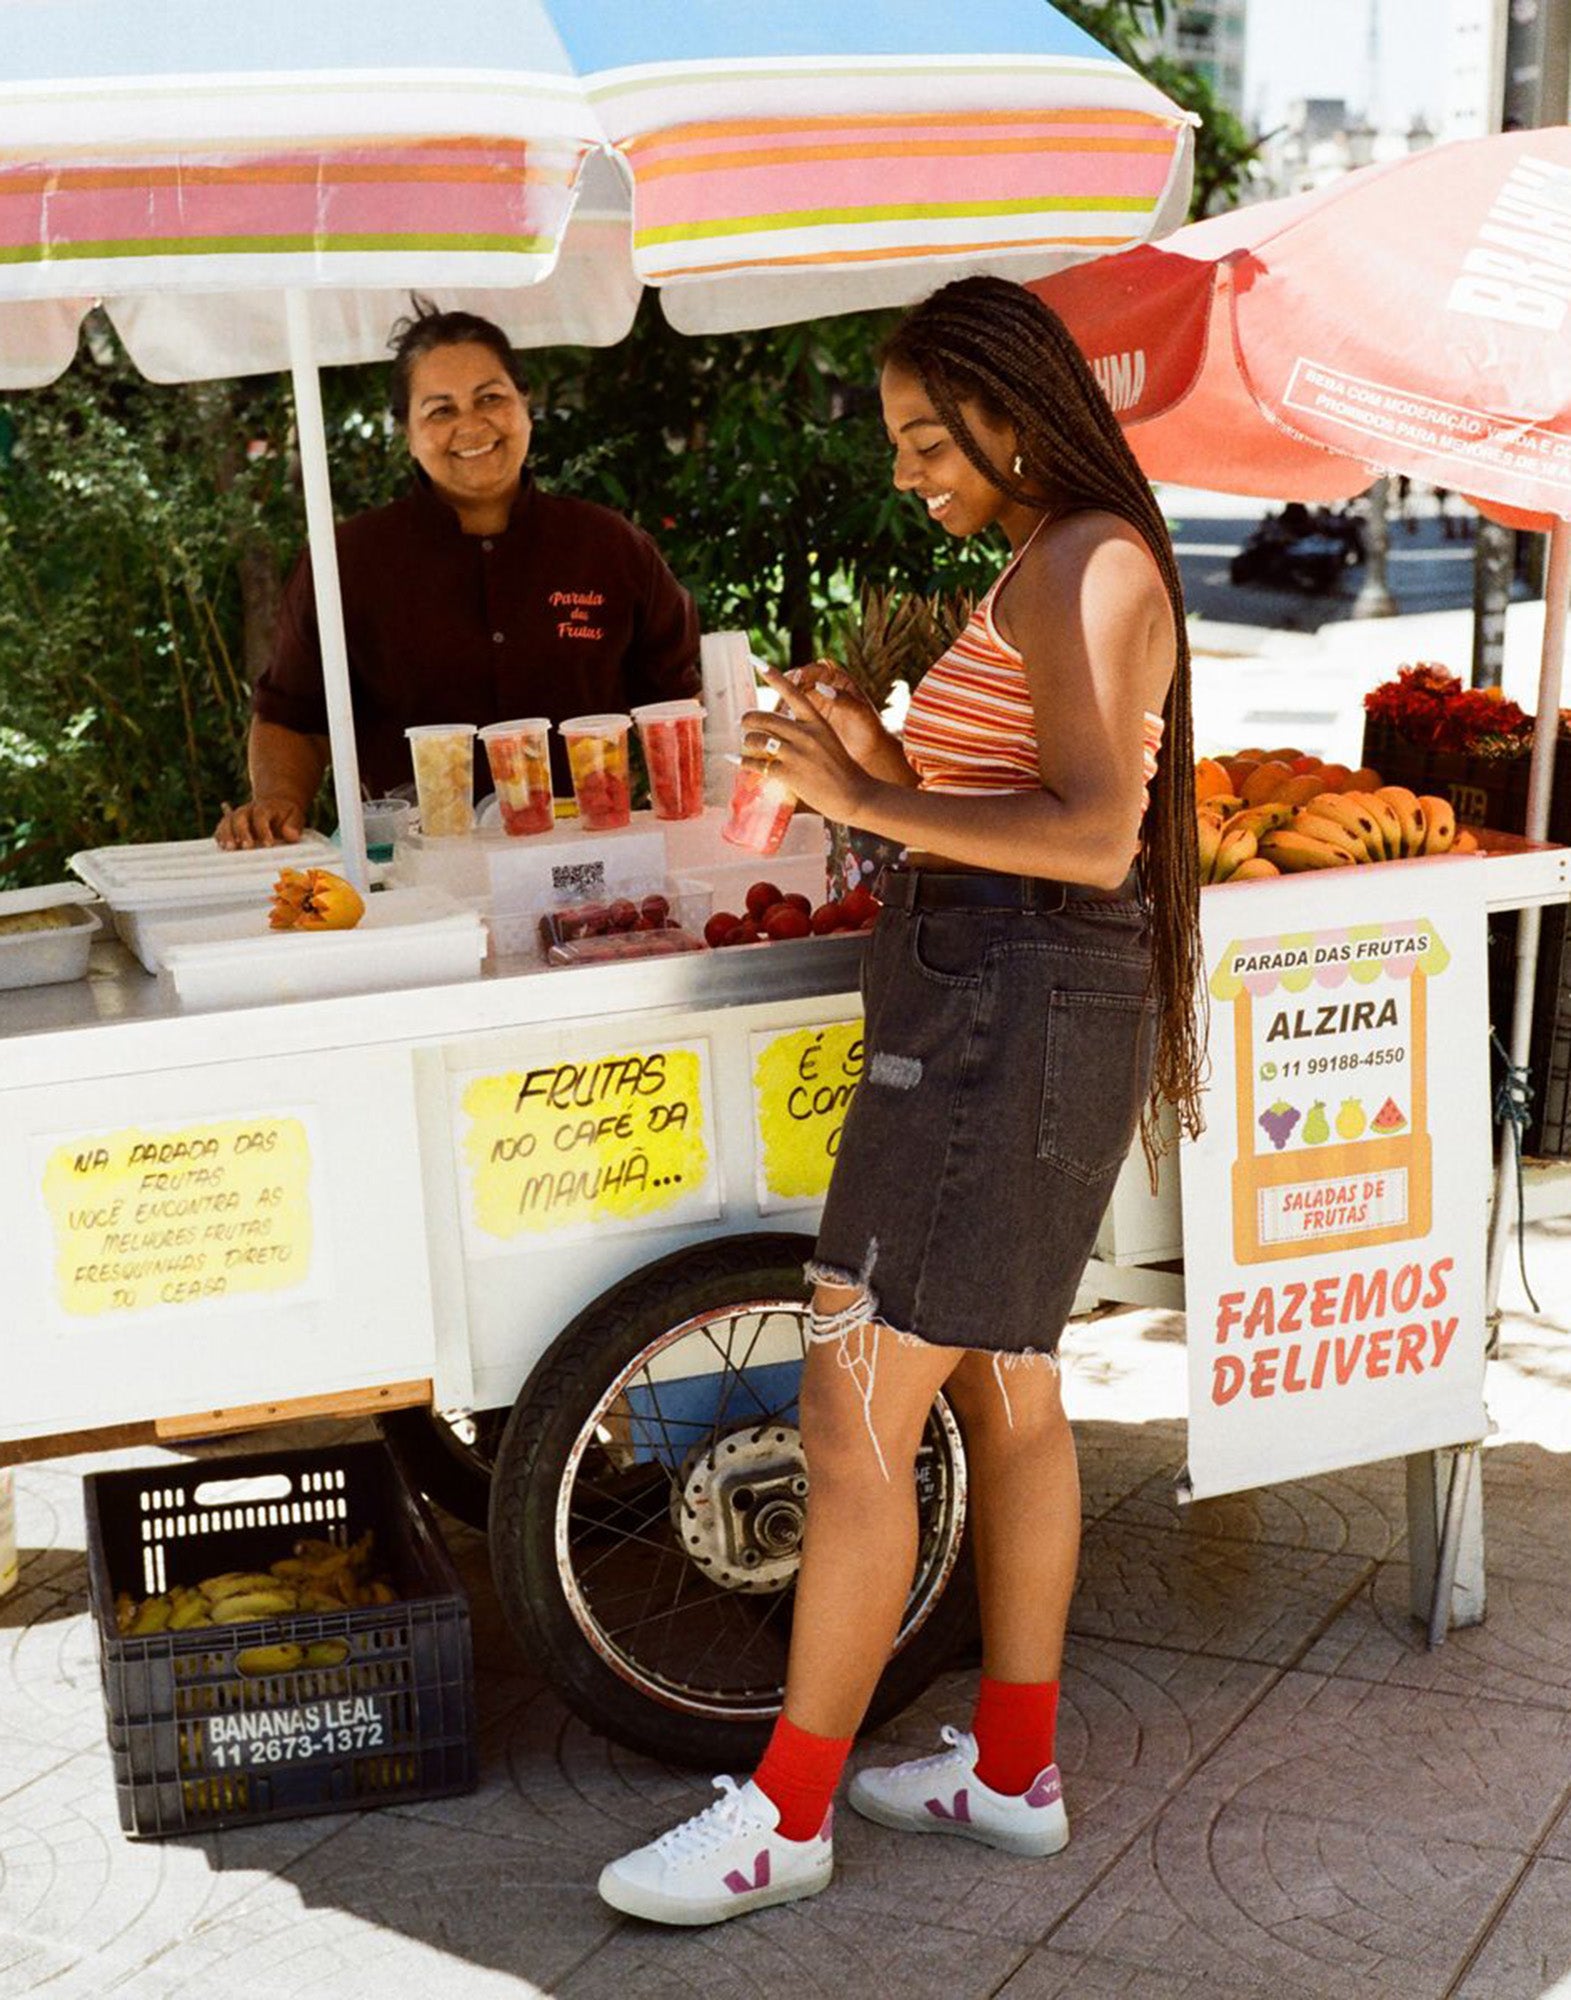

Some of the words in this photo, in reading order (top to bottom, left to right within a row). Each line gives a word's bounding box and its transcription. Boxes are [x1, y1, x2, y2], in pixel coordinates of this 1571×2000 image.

[1086, 349, 1146, 412] HMA
[1305, 369, 1346, 395] BEBA
[1346, 386, 1382, 406] COM
[1396, 421, 1438, 446] PARA
[1439, 434, 1514, 468] MENORES
[549, 590, 606, 606] Parada
[556, 622, 604, 640] Frutas
[1233, 950, 1308, 973] PARADA
[1314, 945, 1351, 964] DAS
[1356, 936, 1428, 959] FRUTAS
[1266, 998, 1398, 1042] ALZIRA
[799, 1032, 825, 1080] É
[1282, 1060, 1301, 1078] 11
[1307, 1047, 1405, 1074] 99188-4550
[515, 1053, 667, 1113] FRUTAS
[74, 1148, 110, 1173] NA
[127, 1137, 220, 1168] PARADA
[233, 1130, 278, 1155] DAS
[490, 1132, 537, 1163] NO
[554, 1102, 635, 1151] CAFÉ
[647, 1101, 689, 1133] DA
[139, 1165, 226, 1193] FRUTAS
[1282, 1184, 1358, 1213] SALADAS
[1363, 1179, 1386, 1200] DE
[134, 1191, 241, 1225] ENCONTRA
[257, 1186, 284, 1207] AS
[1303, 1203, 1369, 1231] FRUTAS
[100, 1226, 197, 1255] MELHORES
[203, 1217, 273, 1243] FRUTAS
[112, 1288, 137, 1308] DO
[1216, 1257, 1454, 1344] FAZEMOS
[1211, 1317, 1459, 1406] DELIVERY
[209, 1706, 321, 1743] BANANAS
[325, 1696, 382, 1729] LEAL
[212, 1743, 241, 1768] 11
[250, 1723, 384, 1765] 2673-1372
